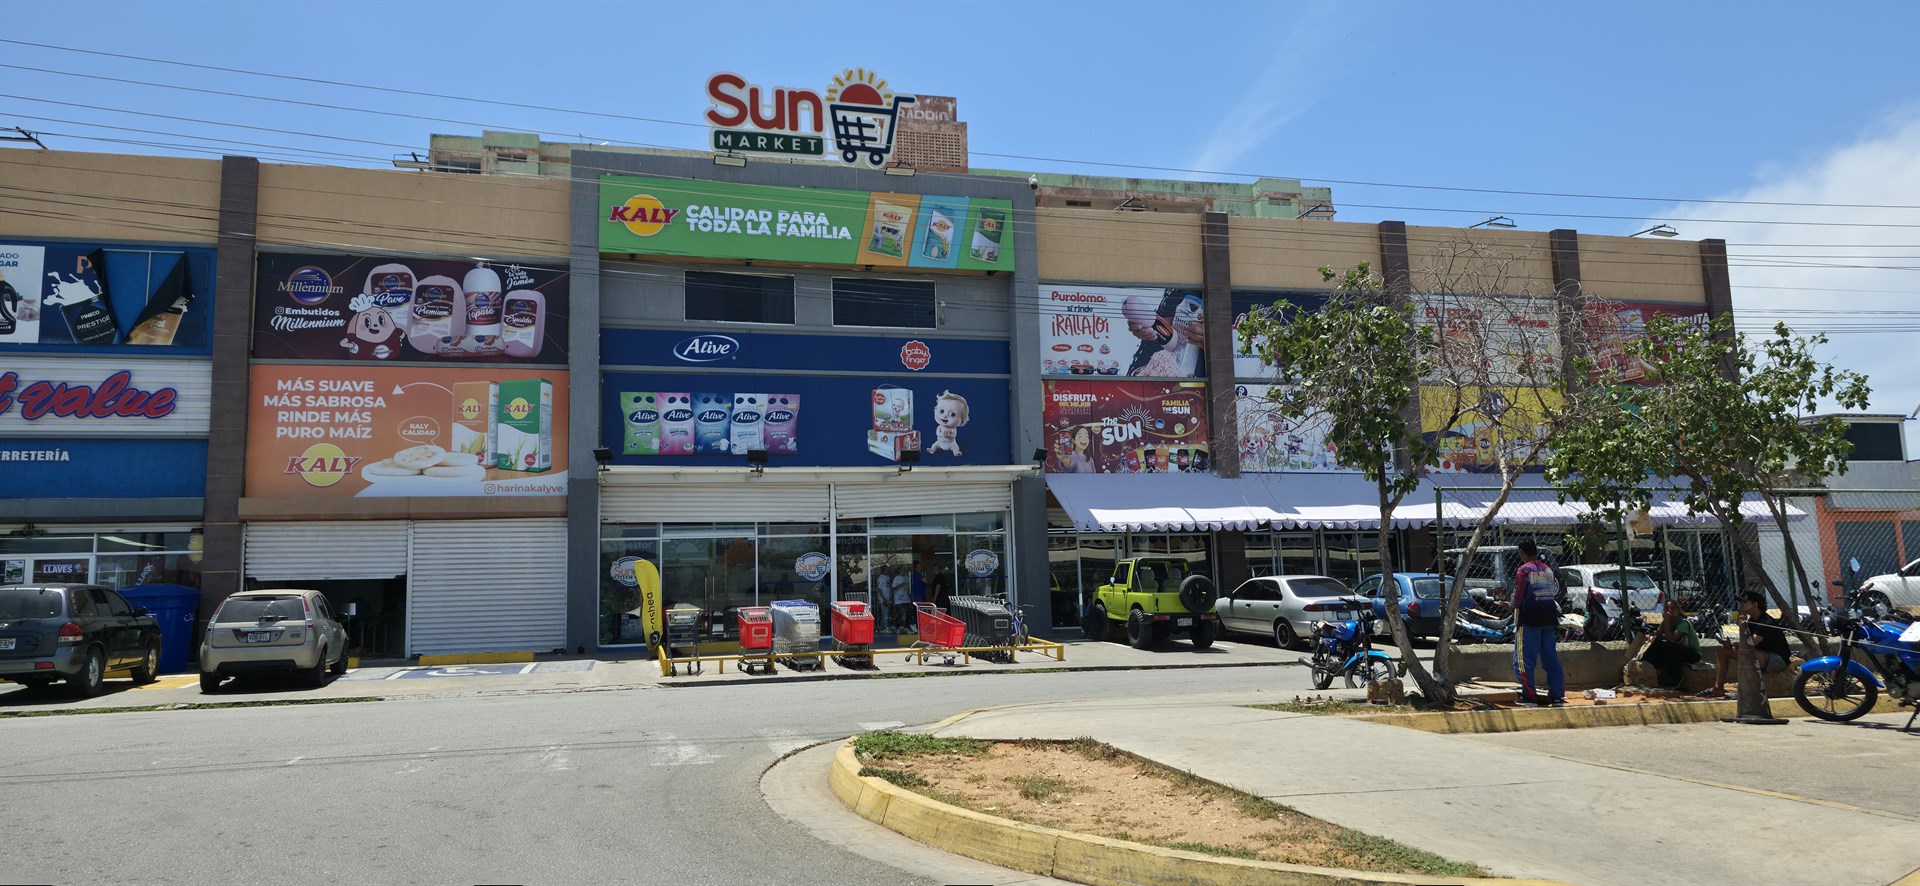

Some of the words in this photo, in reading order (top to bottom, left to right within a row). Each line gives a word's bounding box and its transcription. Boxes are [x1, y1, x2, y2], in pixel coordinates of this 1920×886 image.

[706, 72, 825, 133] Sun
[718, 134, 819, 153] MARKET
[608, 205, 680, 225] KALY
[686, 204, 773, 223] CALIDAD
[882, 211, 903, 221] KALY
[686, 217, 742, 234] TODA
[746, 221, 771, 236] LA
[776, 223, 852, 240] FAMILIA
[932, 221, 951, 231] KALY
[277, 281, 344, 294] Millennium
[375, 293, 406, 305] Pavo
[1051, 290, 1104, 303] Puroloma
[285, 307, 340, 316] Embutidos
[416, 306, 450, 317] Premium
[76, 314, 111, 331] PRESTIGE
[270, 314, 347, 332] Millennium
[682, 337, 731, 357] Alive
[904, 346, 927, 358] baby
[277, 376, 315, 392] MÁS
[319, 380, 374, 393] SUAVE
[17, 370, 177, 420] value
[263, 392, 302, 408] MÁS
[305, 395, 387, 409] SABROSA
[1053, 393, 1098, 402] DISFRUTA
[457, 404, 484, 414] KALY
[503, 403, 535, 414] KALY
[667, 409, 691, 420] Alive
[1172, 406, 1191, 415] SUN
[277, 410, 332, 424] RINDE
[334, 408, 372, 424] MÁS
[633, 411, 657, 421] Alive
[701, 411, 725, 421] Alive
[736, 412, 758, 422] Alive
[769, 411, 791, 421] Alive
[1101, 416, 1118, 427] The
[276, 426, 325, 439] PURO
[329, 423, 372, 439] MAÍZ
[402, 429, 436, 437] CALIDAD
[1101, 420, 1143, 446] SUN
[0, 448, 70, 462] RRETERÍA
[283, 454, 362, 474] KALY
[496, 483, 564, 495] harinakalyve
